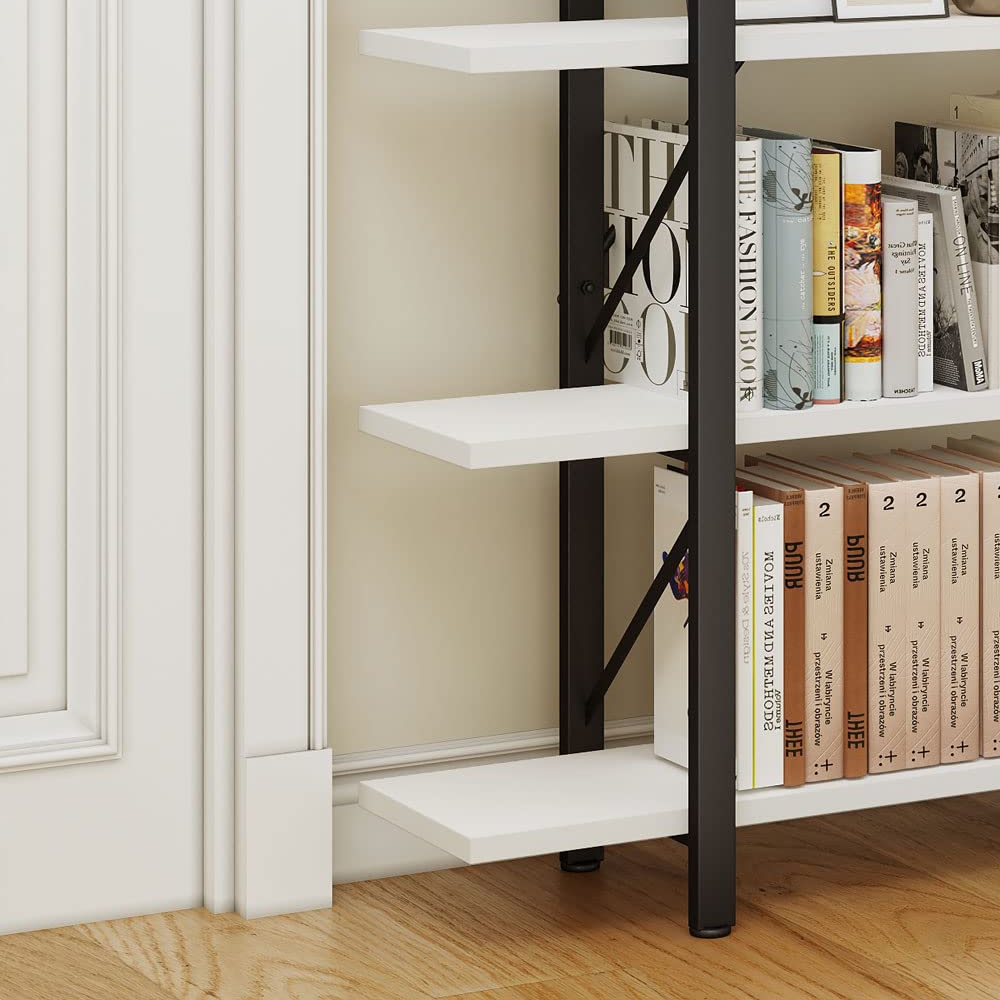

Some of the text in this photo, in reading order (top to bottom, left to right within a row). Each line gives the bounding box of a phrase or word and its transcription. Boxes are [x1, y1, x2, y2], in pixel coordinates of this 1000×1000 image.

[953, 235, 967, 258] ON
[738, 150, 757, 402] THE FASHION BOOK
[827, 245, 837, 312] THE OUTSIDERS
[956, 262, 973, 296] LINE
[973, 359, 986, 385] MoMA
[819, 502, 830, 517] 2
[883, 496, 894, 511] 2
[916, 492, 928, 507] 2
[955, 488, 966, 503] 2
[815, 552, 823, 601] ustawienia
[825, 558, 833, 591] Zmiana
[879, 545, 887, 593] ustawienia
[889, 551, 897, 584] Zmiana
[912, 542, 920, 589] ustawienia
[922, 548, 930, 581] Zmiana
[951, 537, 959, 585] ustawienia
[961, 543, 969, 576] Zmiana
[813, 652, 822, 746] przestrzeni obrazów
[823, 669, 833, 725] W labiryncie
[877, 644, 887, 738] przestrzeni obrazów
[888, 661, 897, 717] W labiryncie
[910, 640, 920, 734] przestrzeni obrazów
[920, 657, 930, 713] W labiryncie
[949, 635, 958, 728] przestrzeni obrazów
[959, 652, 969, 708] W labiryncie
[991, 630, 1000, 723] przestrzeni obrazów
